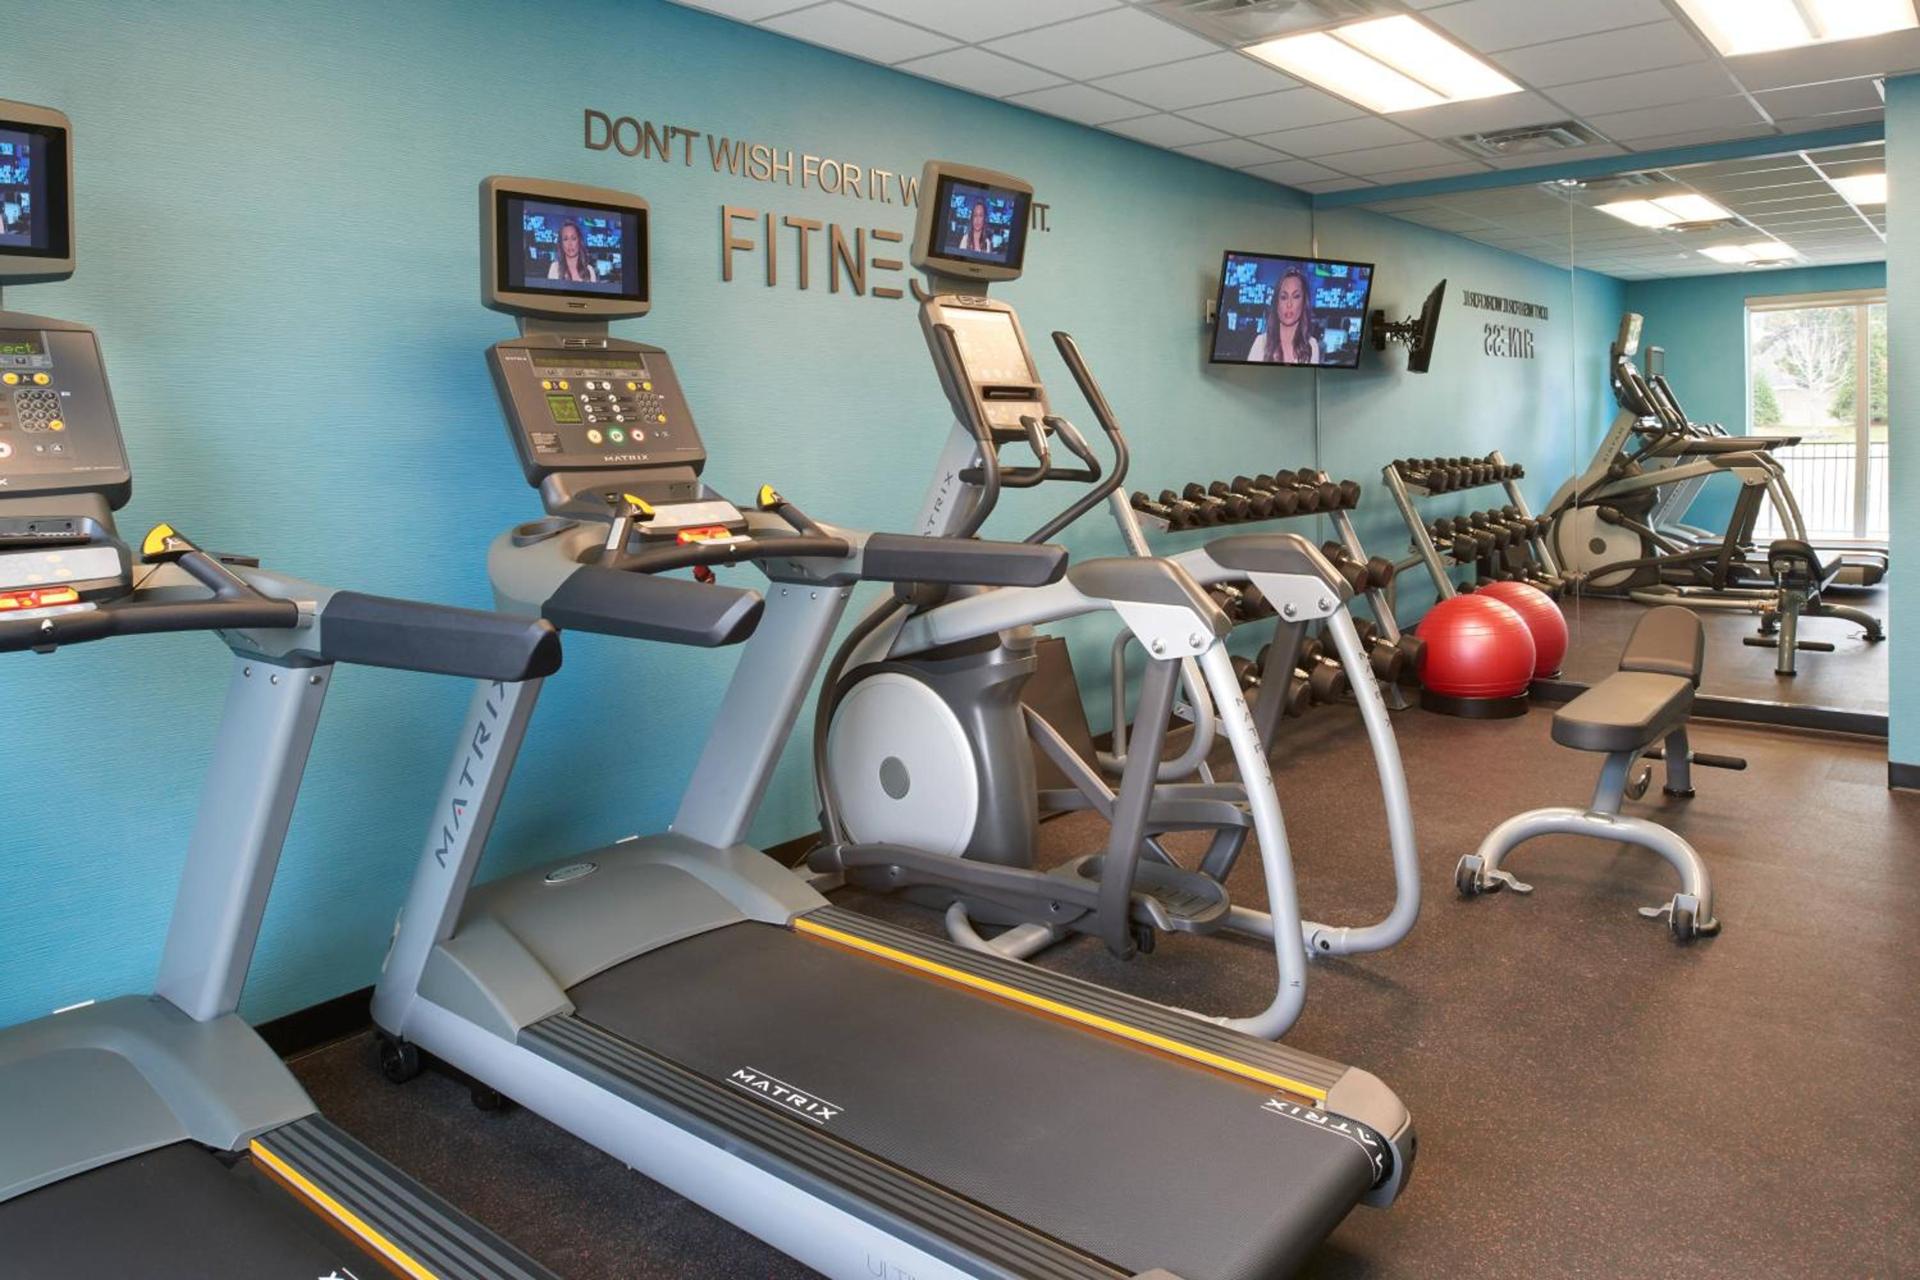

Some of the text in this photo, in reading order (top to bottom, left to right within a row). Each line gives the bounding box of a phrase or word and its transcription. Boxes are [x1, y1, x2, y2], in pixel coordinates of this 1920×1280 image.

[585, 108, 700, 166] DON'T
[707, 133, 794, 185] WISH
[801, 153, 863, 199] FOR
[869, 167, 893, 204] IT.
[722, 204, 934, 304] FITNE
[923, 471, 954, 537] TRIX
[731, 1069, 839, 1120] MATRIX
